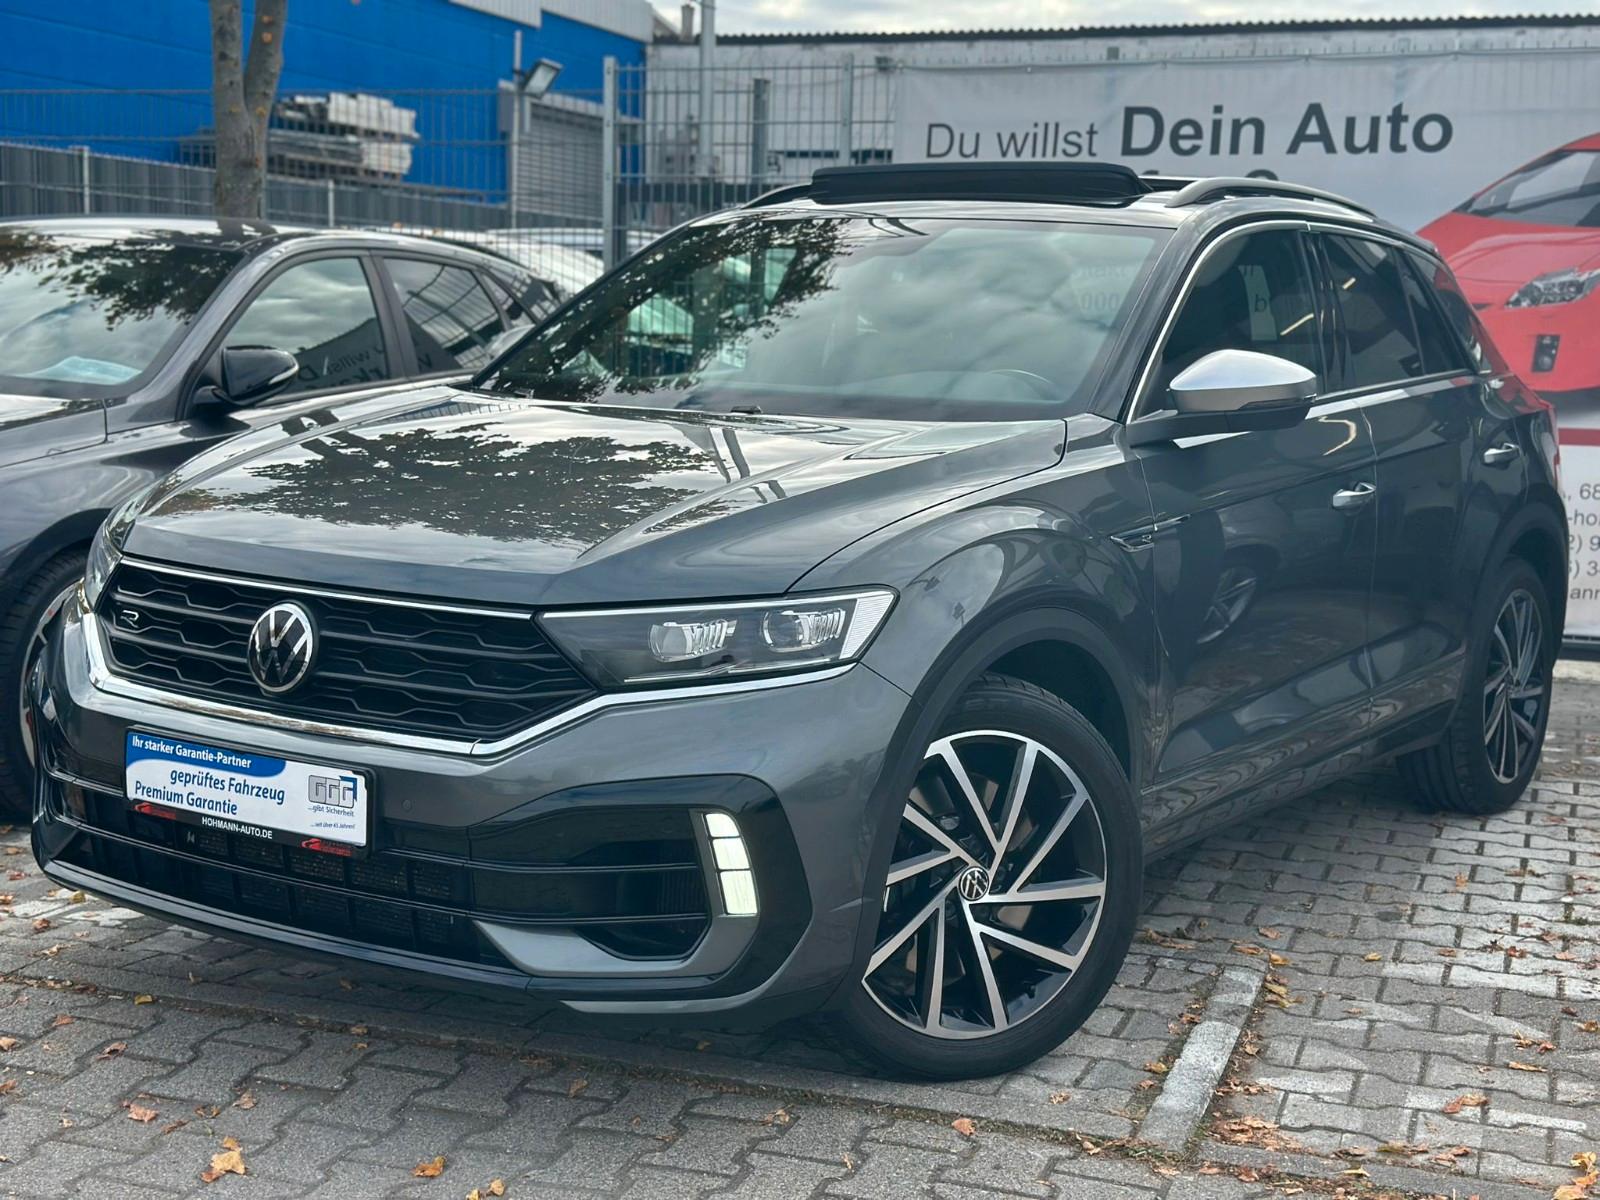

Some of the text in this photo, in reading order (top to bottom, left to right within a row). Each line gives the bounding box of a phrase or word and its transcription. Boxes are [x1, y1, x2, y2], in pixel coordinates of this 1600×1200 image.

[925, 101, 1454, 158] Du willst Dein Auto
[1567, 508, 1600, 526] -ho
[132, 735, 252, 769] Ihr starker Garantie-Partner
[135, 780, 184, 804] Premium
[186, 791, 238, 816] Garantie
[170, 769, 285, 806] geprüftes Fahrzeug
[201, 816, 273, 839] HOHMANN-AUTO.DE
